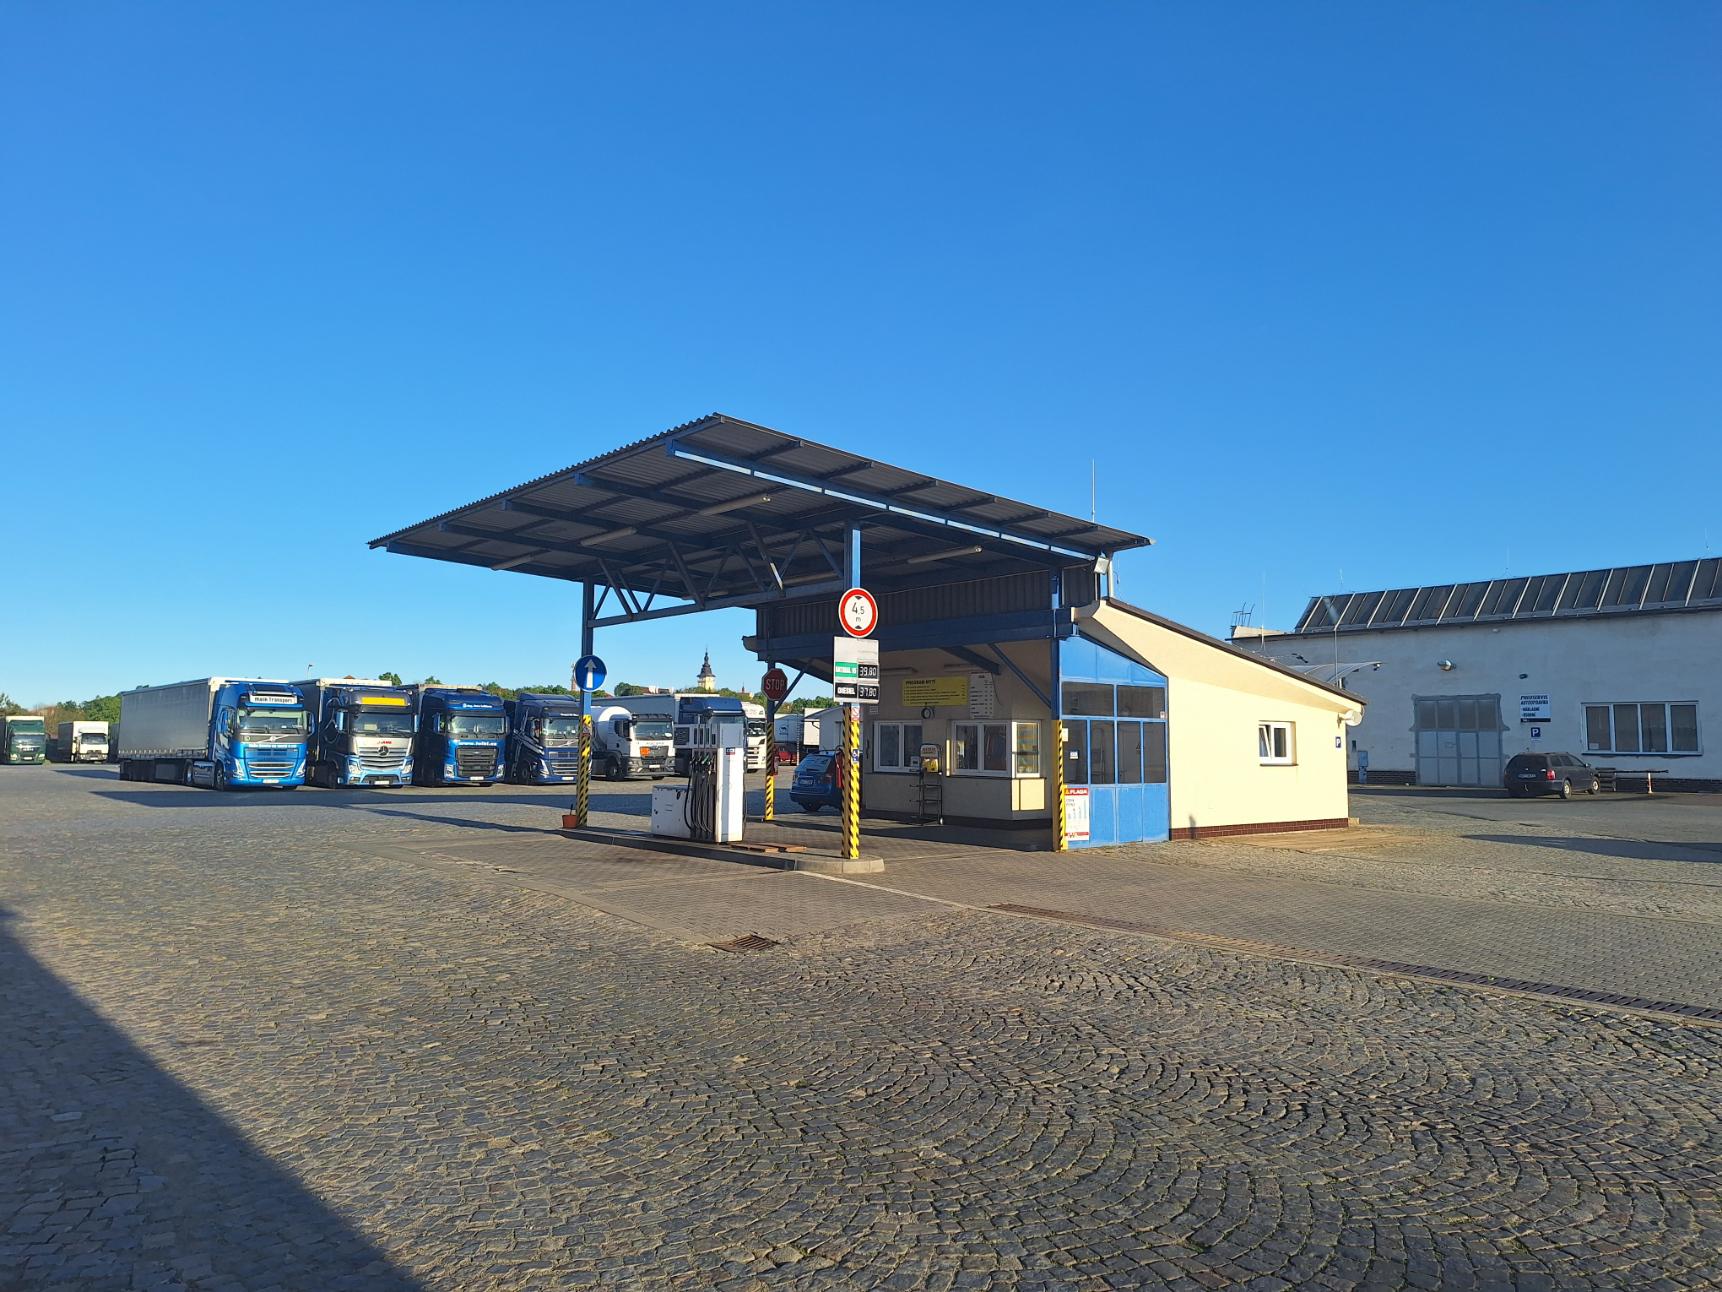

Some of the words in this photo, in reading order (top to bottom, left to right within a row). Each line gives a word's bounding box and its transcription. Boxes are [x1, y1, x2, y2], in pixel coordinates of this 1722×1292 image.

[860, 666, 876, 677] 39.80
[765, 679, 785, 691] STOP
[837, 687, 855, 695] DIESEL
[860, 687, 876, 698] 37.80
